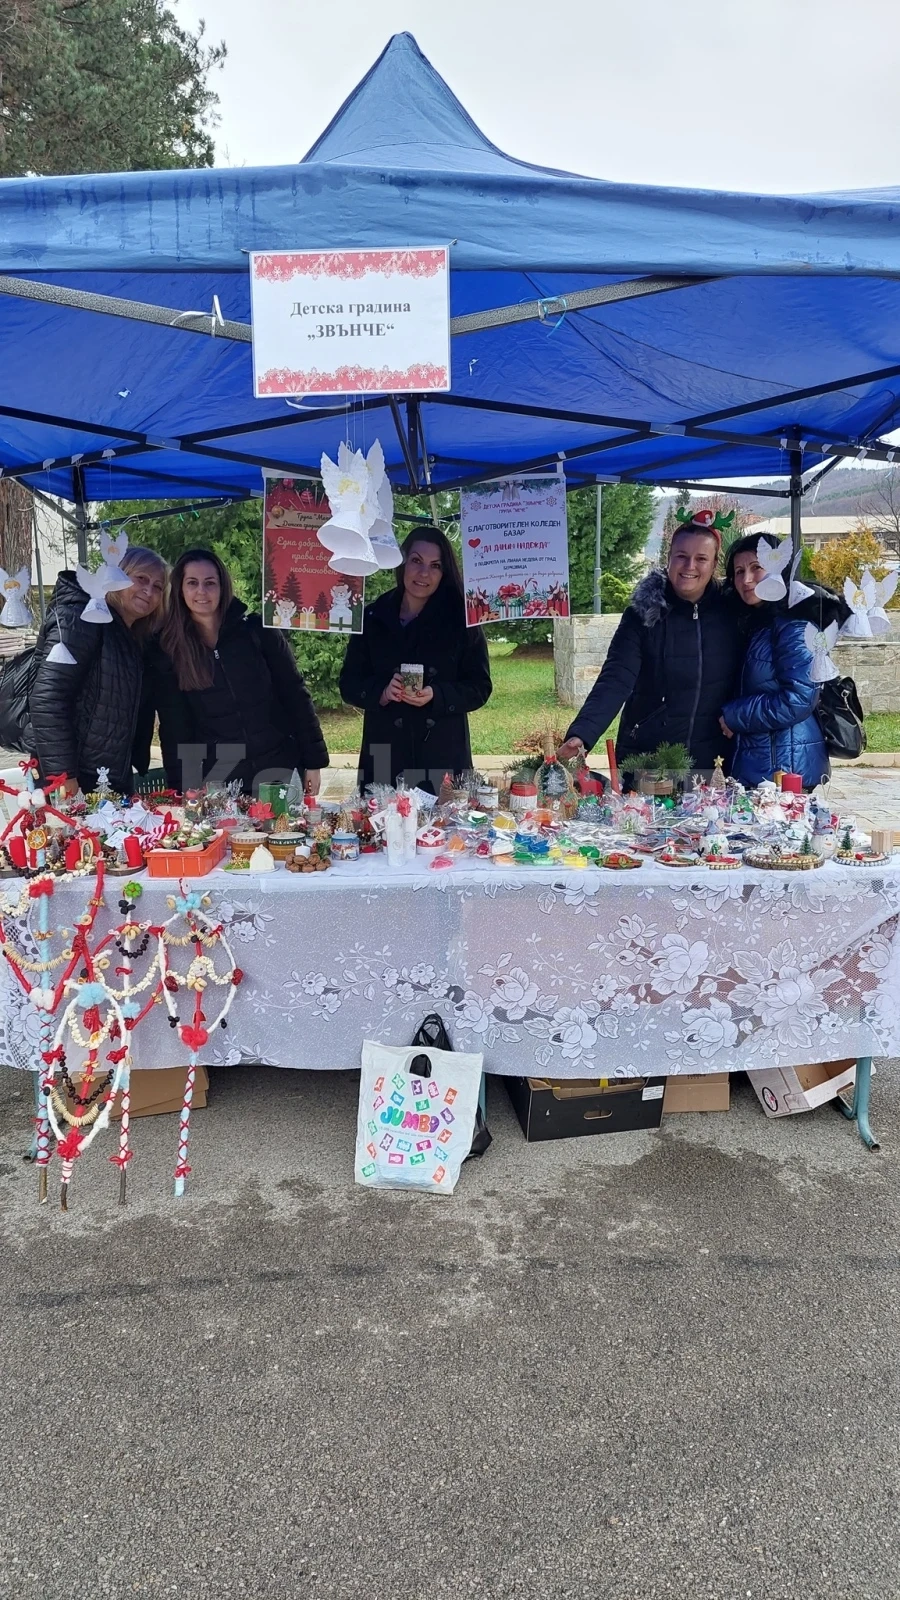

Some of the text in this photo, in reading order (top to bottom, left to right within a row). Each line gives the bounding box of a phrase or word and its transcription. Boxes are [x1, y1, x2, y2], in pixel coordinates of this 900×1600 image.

[290, 301, 412, 317] Детска градина
[307, 323, 395, 341] „ЗВЪНЧЕ“
[468, 520, 561, 533] БЛАГОТВОРИТЕЛЕН КОЛЕДЕН
[503, 529, 526, 537] БАЗАР
[276, 536, 322, 551] Една добри
[291, 550, 315, 564] прави
[380, 1105, 440, 1133] JUMBO
